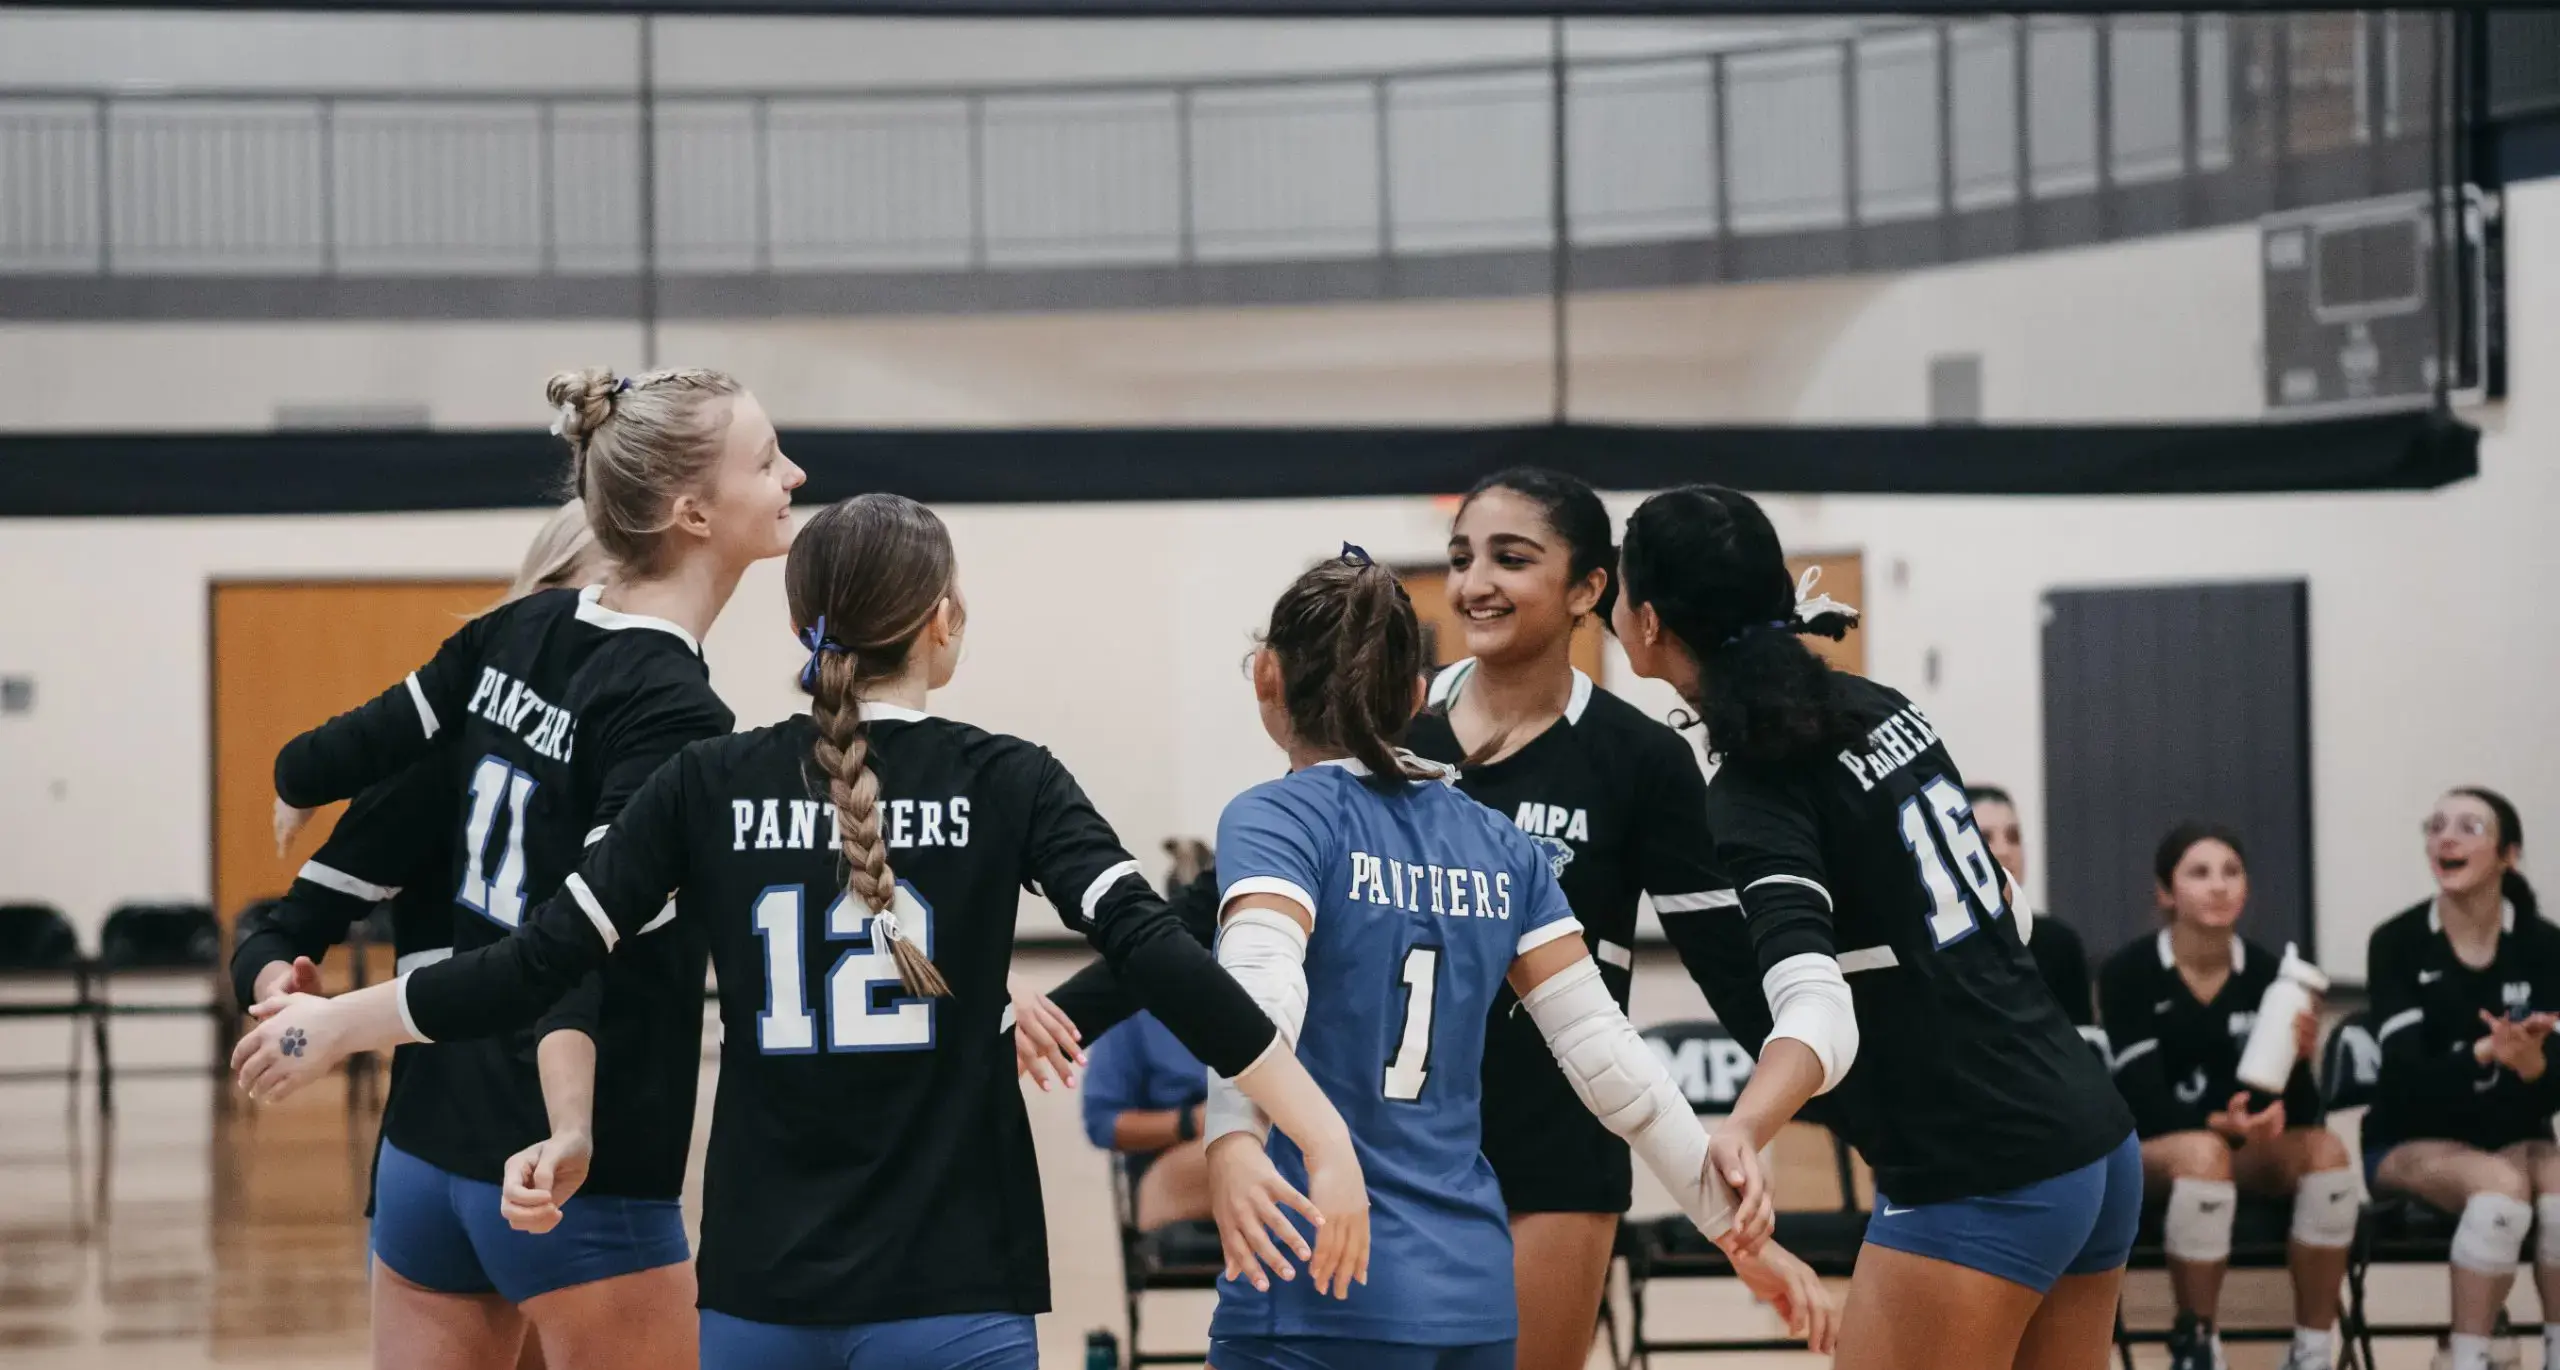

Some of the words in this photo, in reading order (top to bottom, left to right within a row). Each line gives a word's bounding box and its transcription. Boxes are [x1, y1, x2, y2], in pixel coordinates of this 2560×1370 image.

[456, 753, 539, 931] 11
[1349, 851, 1511, 920] PANTHERS
[1514, 801, 1589, 842] MPA
[1898, 773, 2003, 951] 16
[752, 879, 936, 1055] 12
[1383, 943, 1443, 1104] 1
